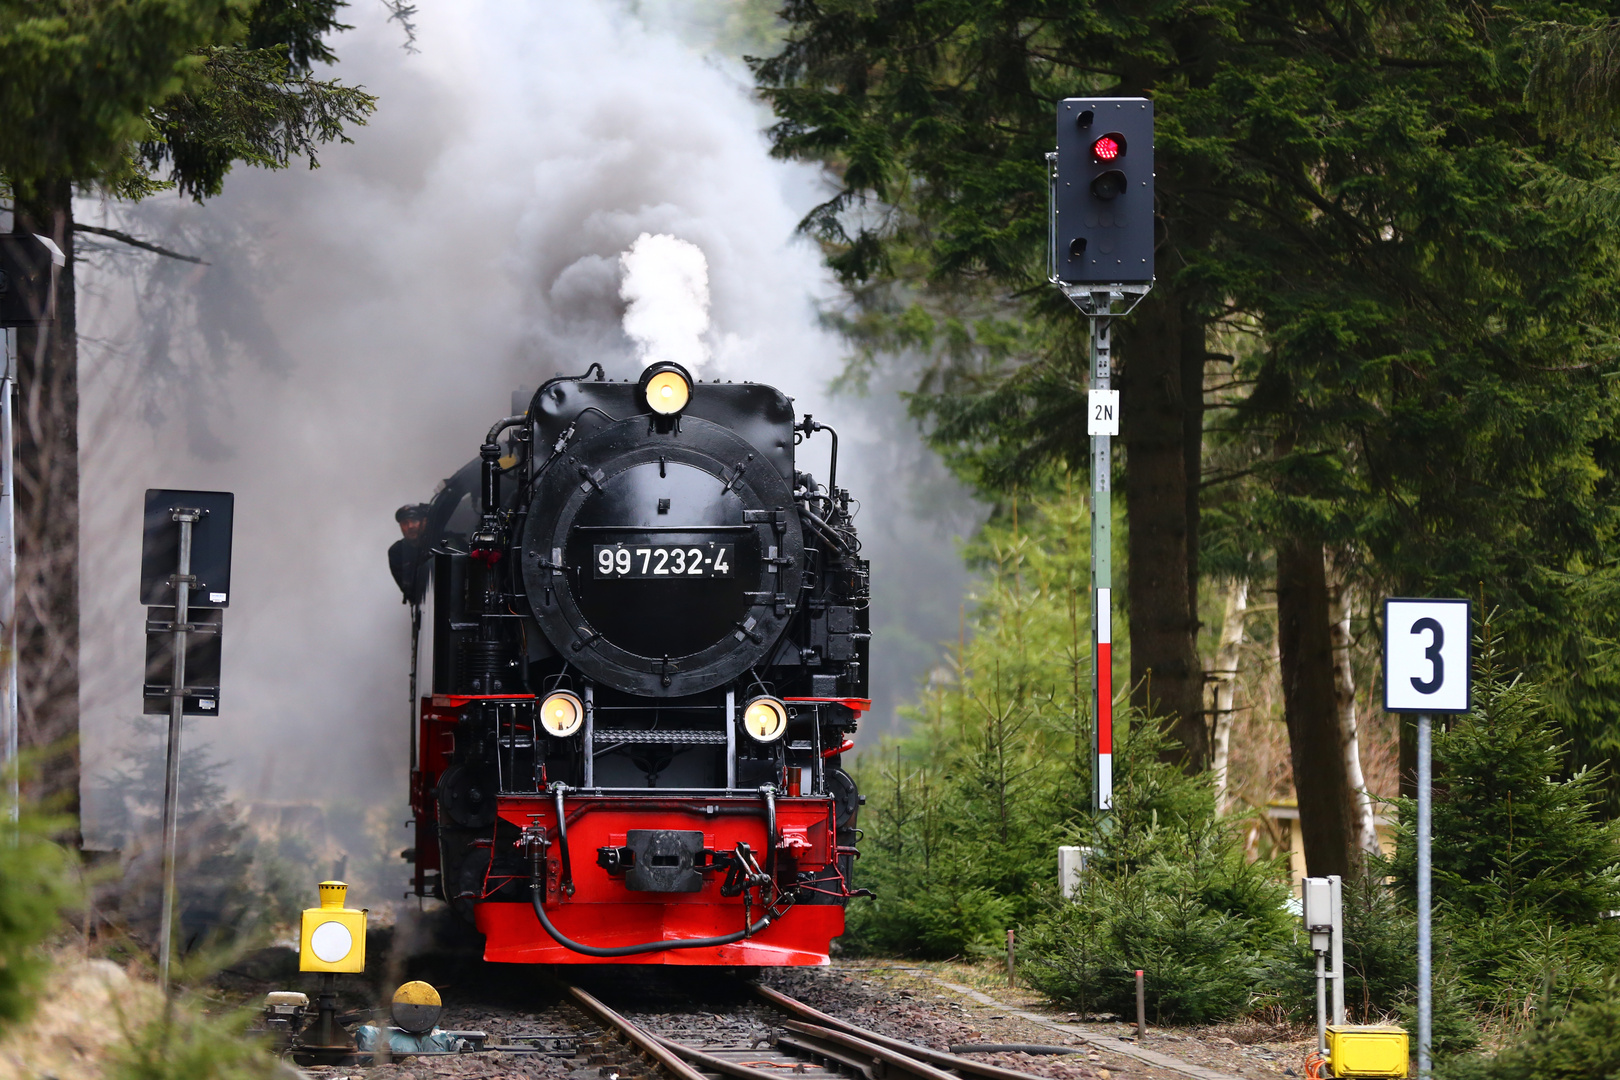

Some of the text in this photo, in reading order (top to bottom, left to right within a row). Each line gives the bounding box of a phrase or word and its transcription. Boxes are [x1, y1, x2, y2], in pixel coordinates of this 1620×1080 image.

[1095, 404, 1113, 421] 2N
[598, 548, 729, 575] 99 7232-4
[1410, 617, 1445, 695] 3
